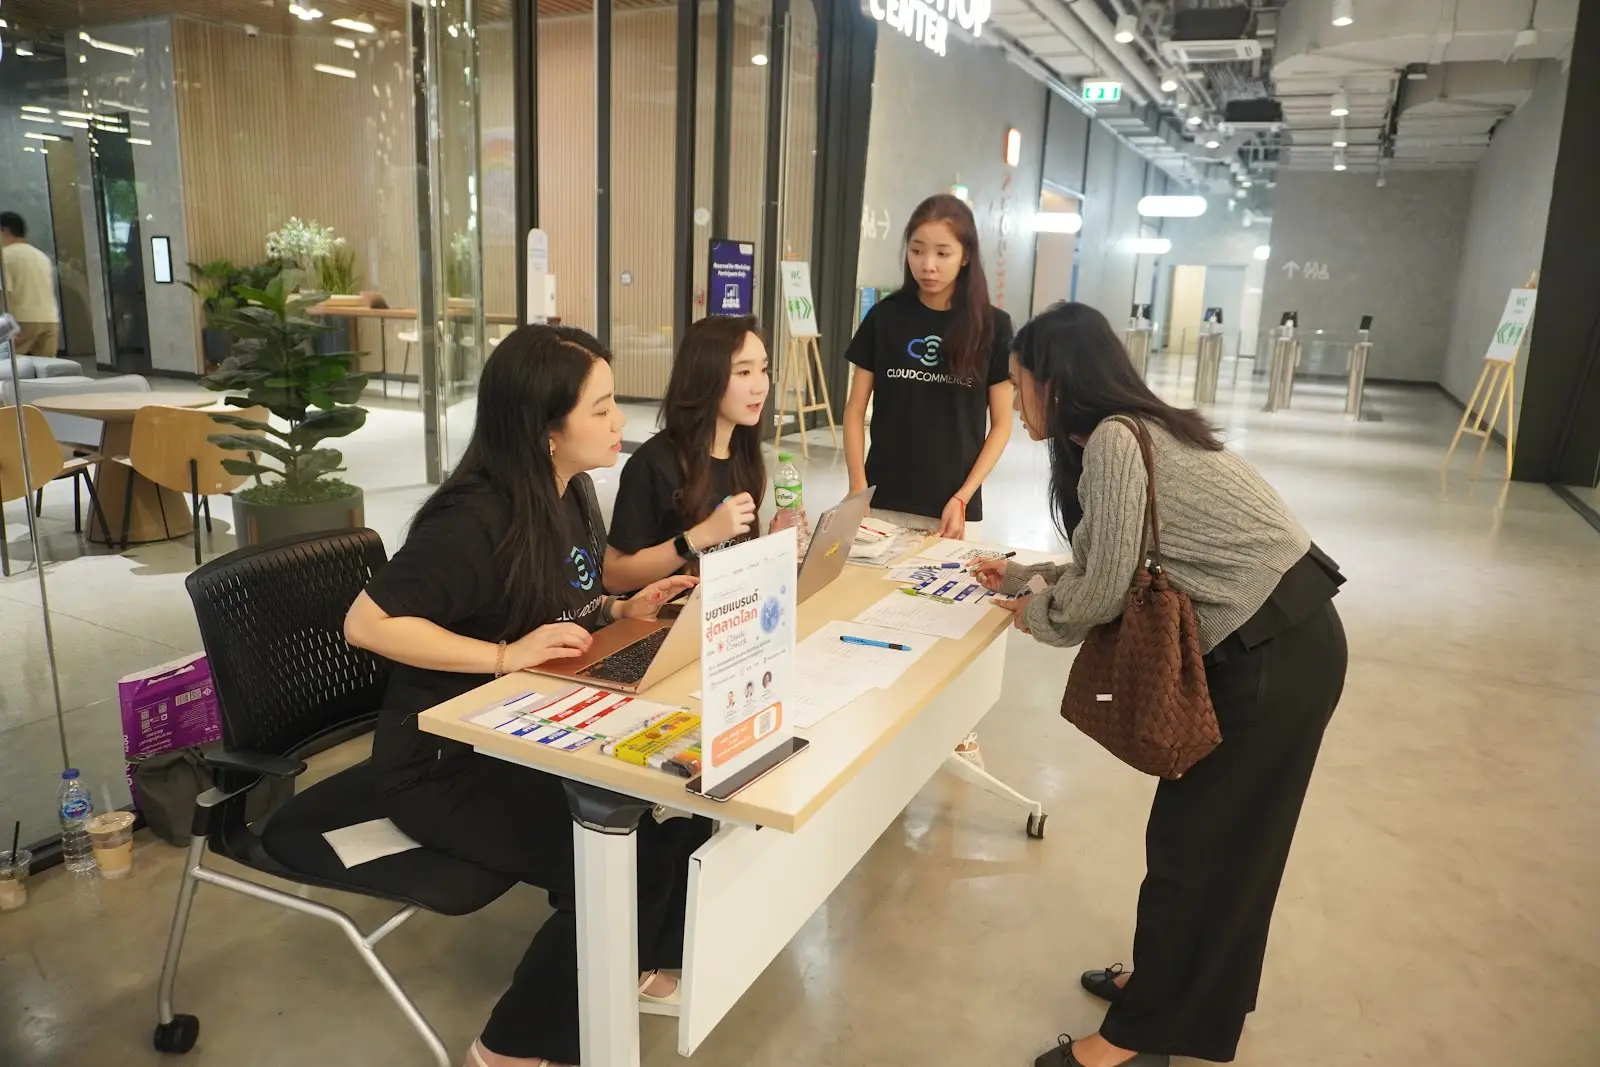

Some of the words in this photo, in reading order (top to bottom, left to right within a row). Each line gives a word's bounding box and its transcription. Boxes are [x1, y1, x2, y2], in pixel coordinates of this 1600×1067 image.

[790, 270, 802, 280] WC
[1516, 297, 1528, 307] WC
[886, 368, 973, 387] CLOUDCOMMERCE
[705, 588, 759, 621] ขยายแบรนด์
[706, 607, 759, 643] สู่ตลาดโลก
